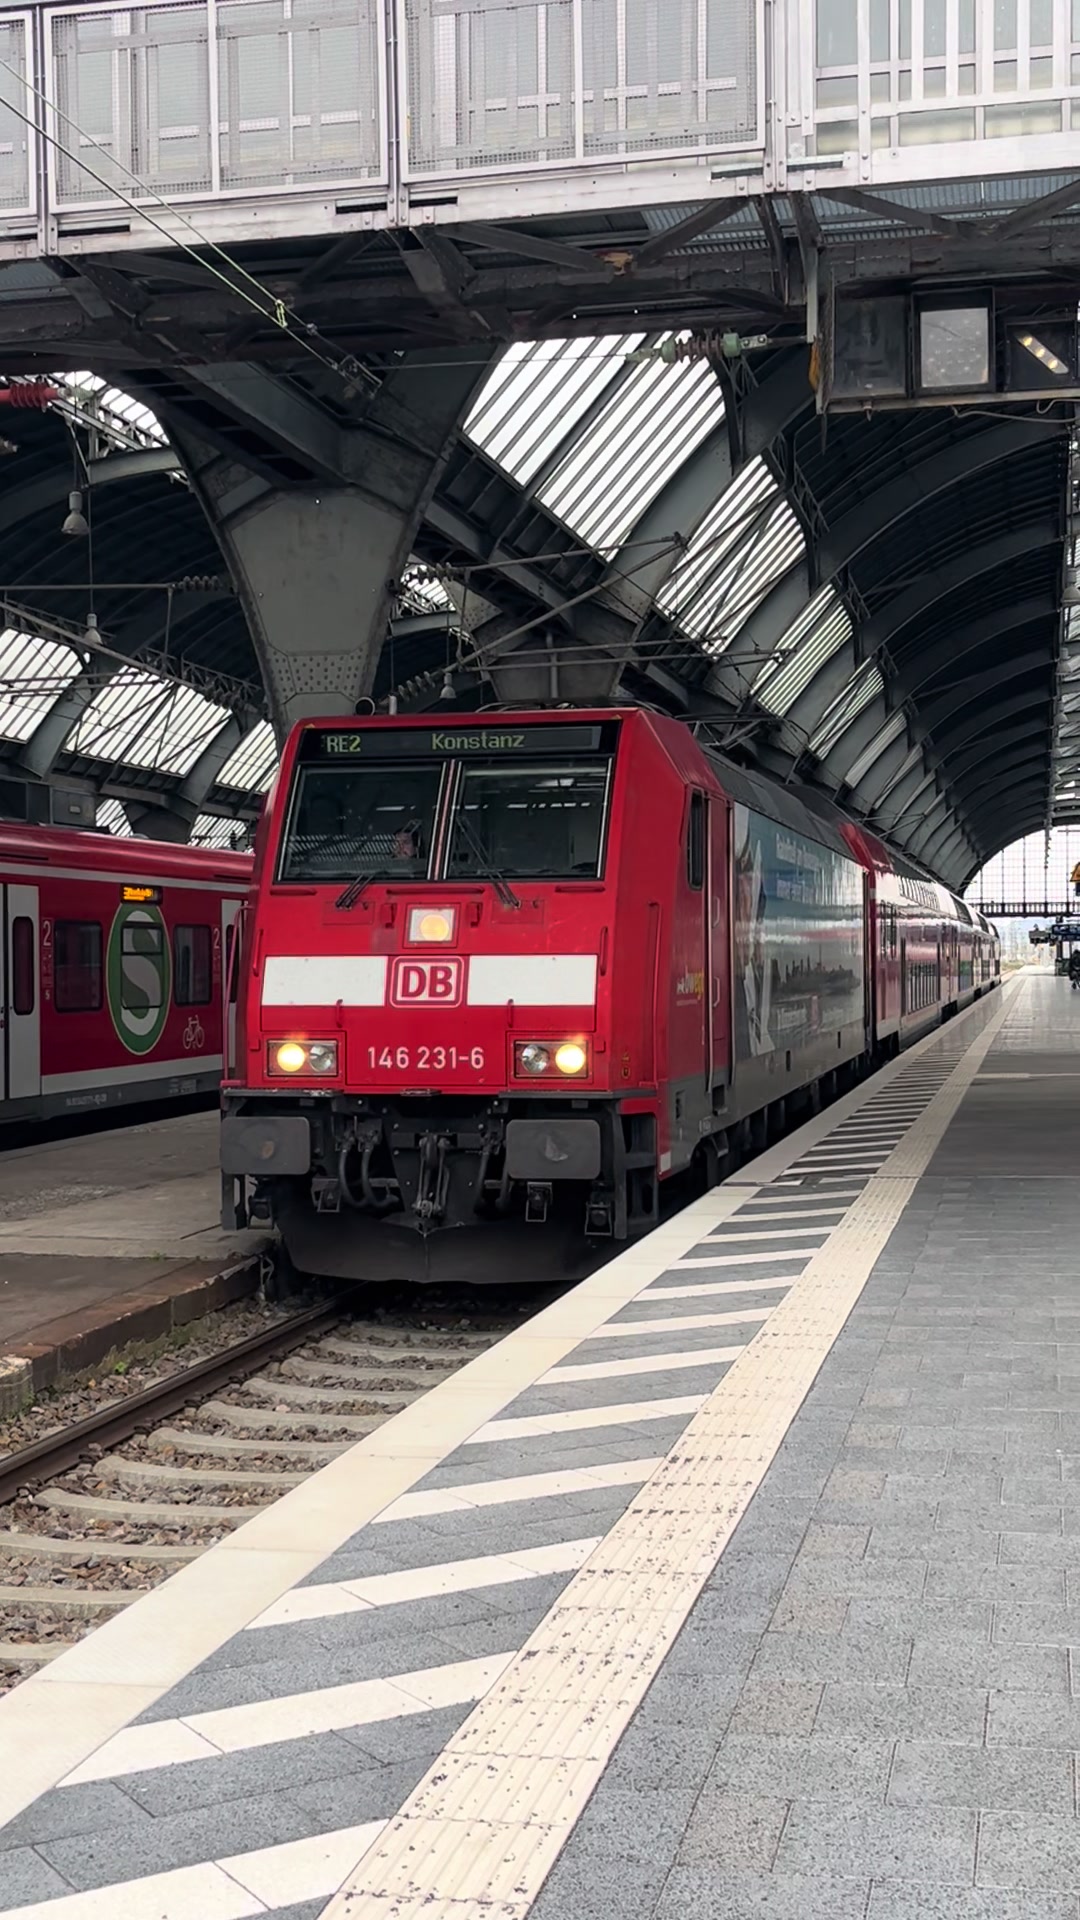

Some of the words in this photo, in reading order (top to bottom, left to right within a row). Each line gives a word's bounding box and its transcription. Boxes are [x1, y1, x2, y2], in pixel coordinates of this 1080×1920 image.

[327, 735, 361, 752] RE2
[431, 732, 524, 749] Konstanz
[43, 920, 51, 946] 2
[213, 927, 220, 949] 2
[401, 965, 453, 998] DB
[368, 1046, 409, 1069] 146
[417, 1046, 485, 1069] 231-6
